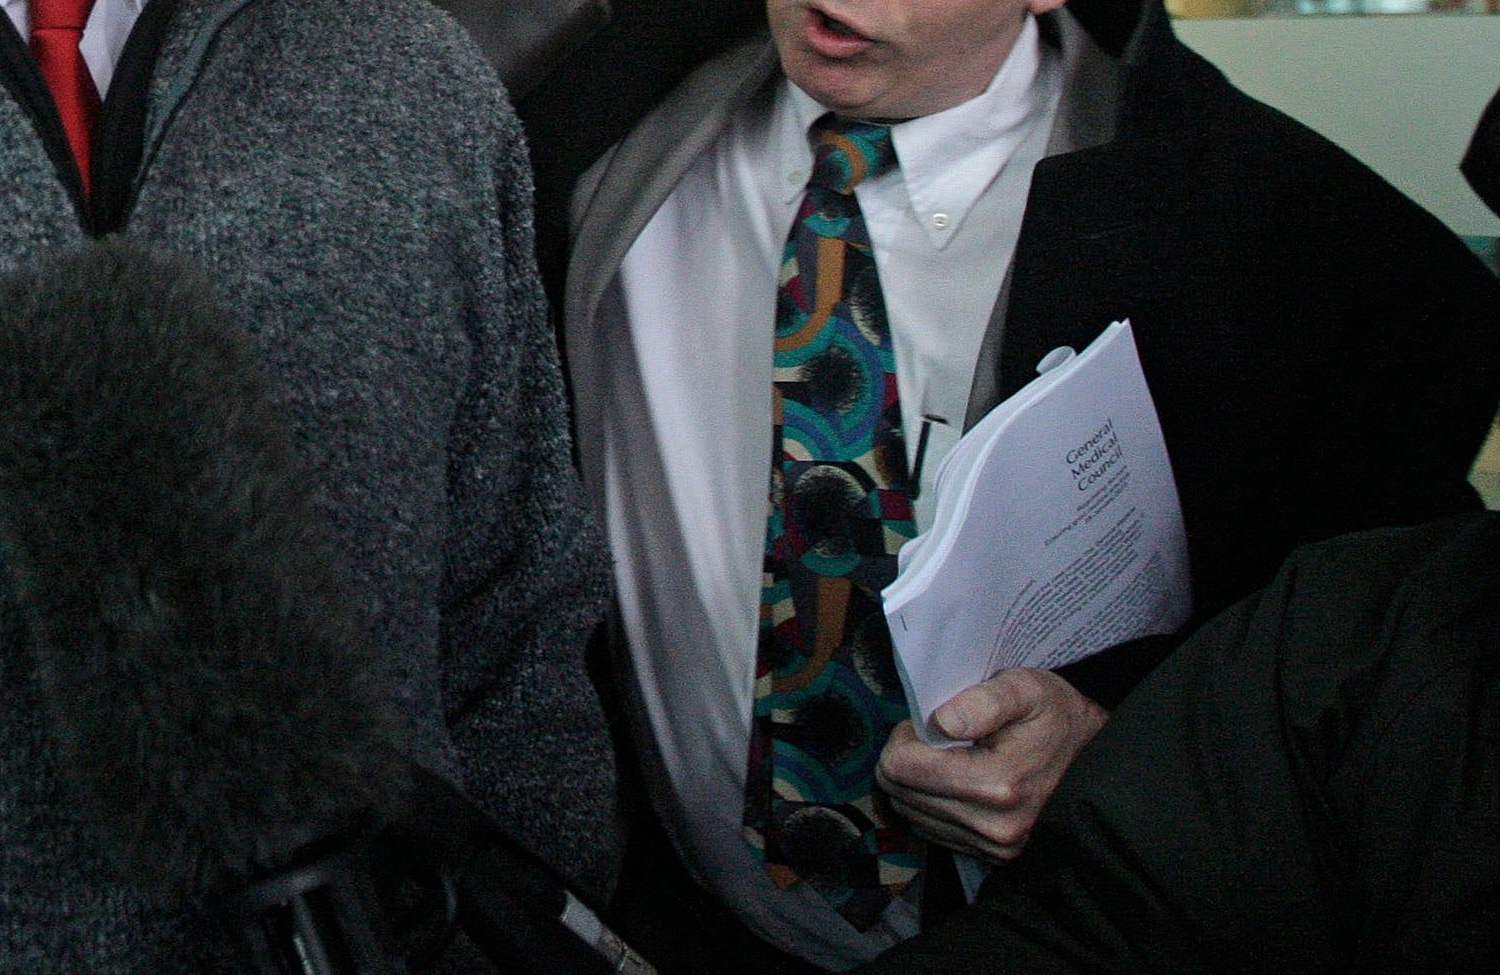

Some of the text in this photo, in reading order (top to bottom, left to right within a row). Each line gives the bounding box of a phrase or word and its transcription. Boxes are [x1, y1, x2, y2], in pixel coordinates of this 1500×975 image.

[1066, 417, 1113, 464] General
[1070, 431, 1119, 480] Medical
[1077, 445, 1123, 492] Council
